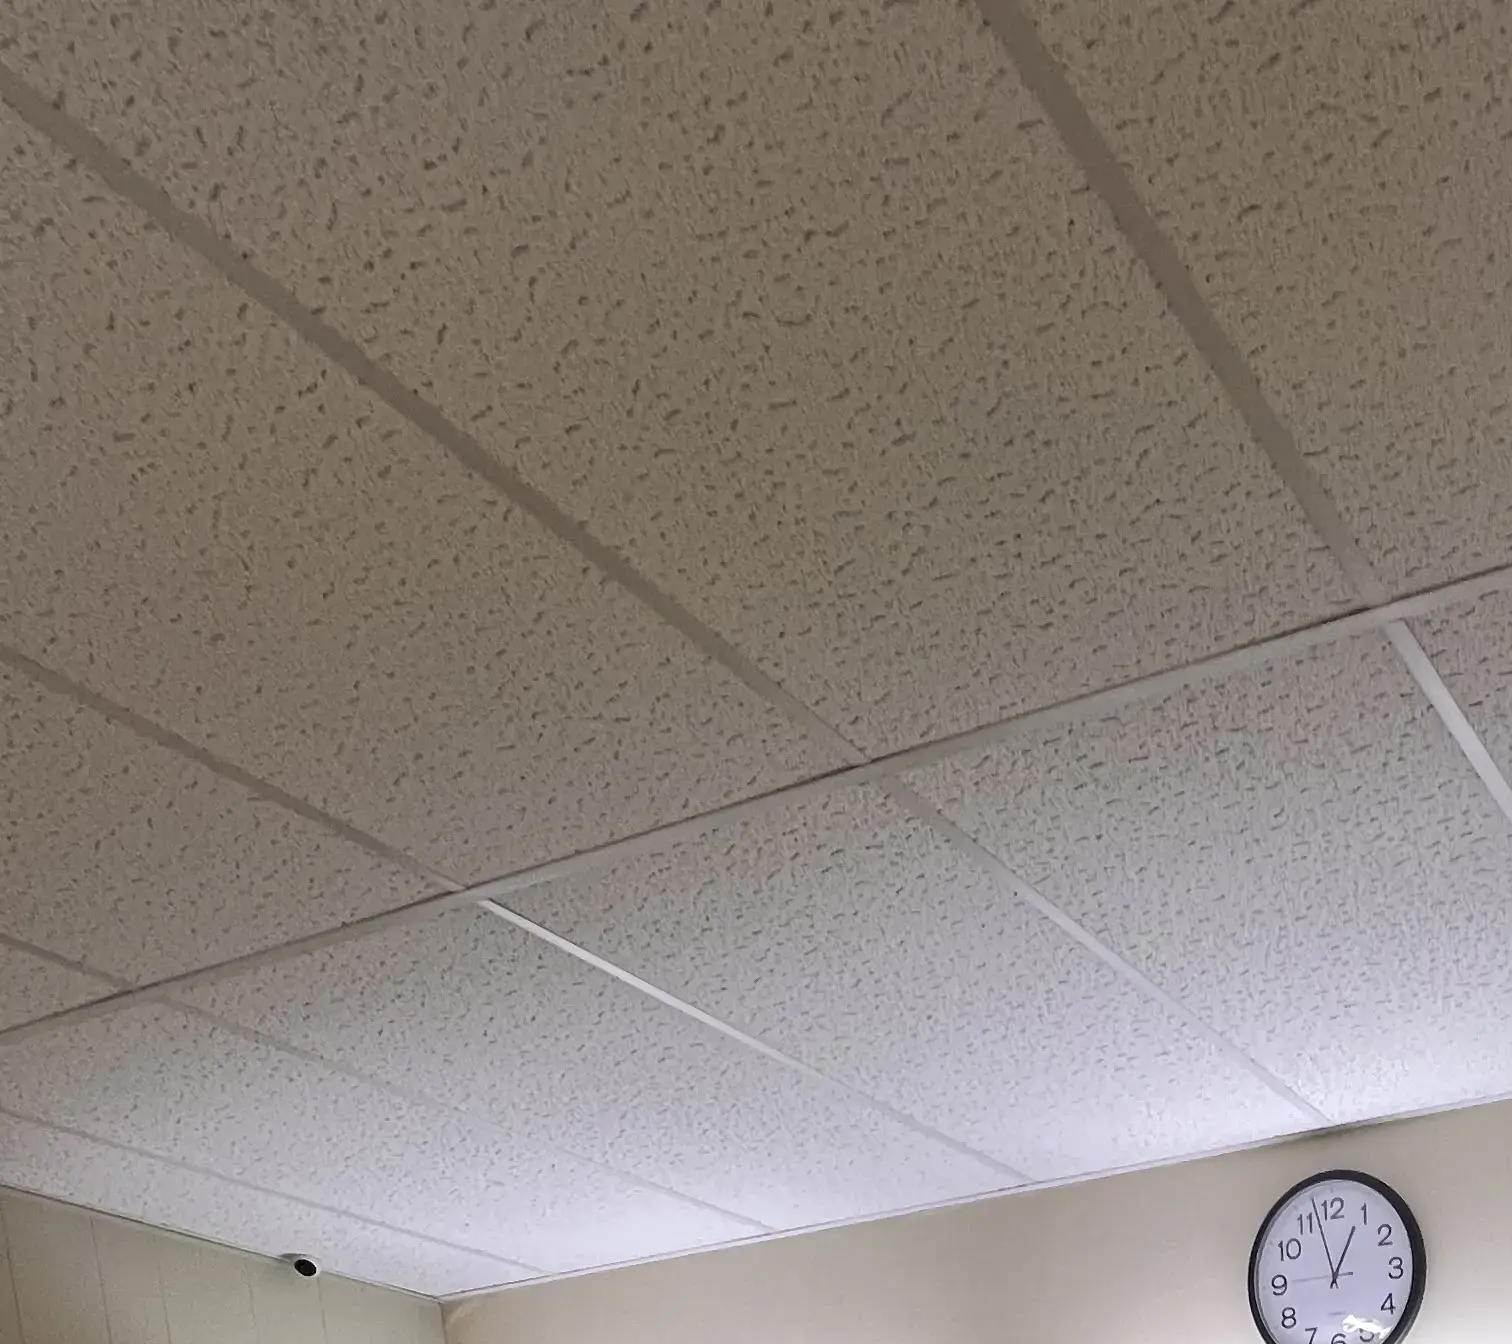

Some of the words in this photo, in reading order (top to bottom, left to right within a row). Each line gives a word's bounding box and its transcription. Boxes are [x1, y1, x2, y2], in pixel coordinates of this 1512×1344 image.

[1320, 1197, 1345, 1221] 12
[1360, 1202, 1368, 1226] 1
[1297, 1212, 1314, 1235] 11
[1377, 1223, 1393, 1247] 2
[1277, 1238, 1302, 1262] 10
[1388, 1256, 1404, 1280] 3
[1271, 1274, 1288, 1296] 9
[1380, 1292, 1397, 1315] 4
[1281, 1306, 1297, 1329] 8
